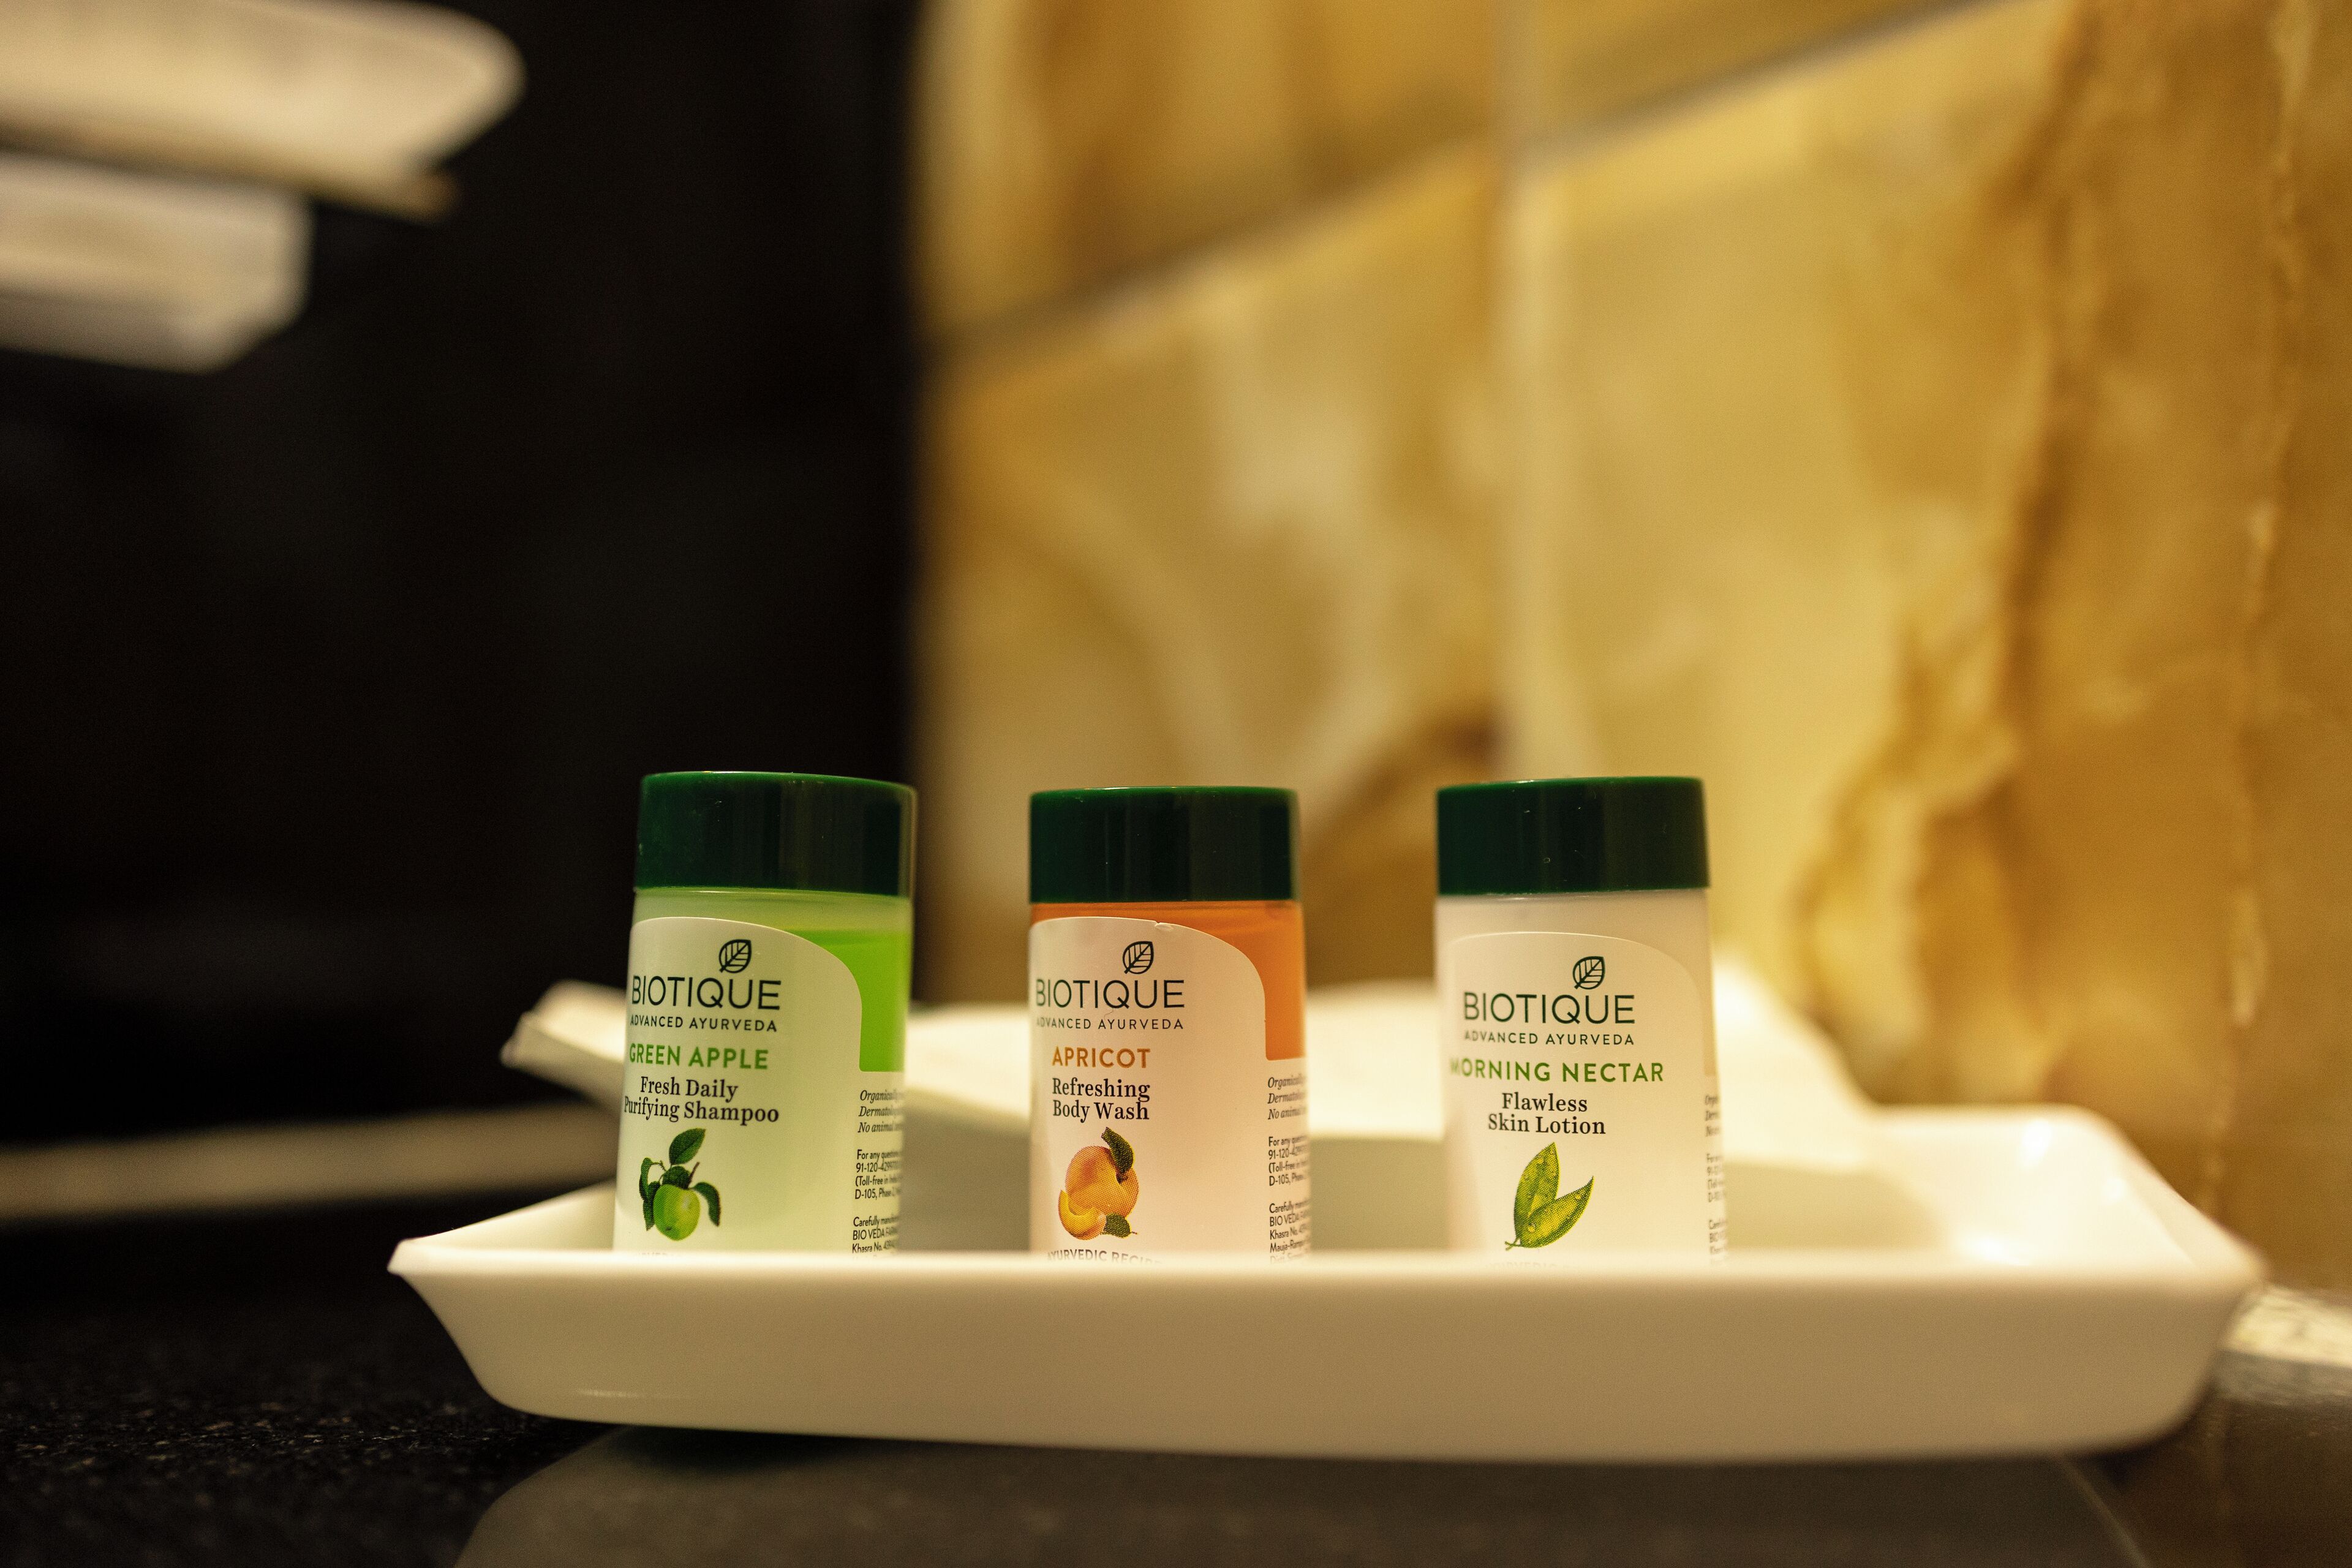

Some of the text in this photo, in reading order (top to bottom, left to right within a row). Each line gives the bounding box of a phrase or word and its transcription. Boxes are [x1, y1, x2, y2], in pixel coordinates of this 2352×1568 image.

[631, 975, 782, 1011] BIOTIQUE
[1036, 979, 1185, 1009] BIOTIQUE
[1463, 992, 1635, 1024] BIOTIQUE
[630, 1015, 777, 1032] ADVANCED AYURVEDA
[1036, 1017, 1183, 1030] ADVANCED AYURVEDA
[1464, 1031, 1634, 1045] ADVANCED AYURVEDA
[629, 1043, 769, 1069] GREEN APPLE
[1052, 1046, 1150, 1069] APRICOT
[1450, 1058, 1664, 1082] MORNING NECTAR
[640, 1076, 738, 1102] Fresh Daily
[1052, 1077, 1150, 1102] Refreshing
[1502, 1092, 1588, 1112] Flawless
[624, 1096, 779, 1126] Purifying Shampoo
[1053, 1099, 1150, 1123] Body Wash
[1268, 1109, 1279, 1120] No
[858, 1122, 870, 1133] No
[1488, 1114, 1606, 1134] Skin Lotion
[1268, 1136, 1280, 1147] For
[1281, 1139, 1291, 1149] any
[857, 1149, 869, 1159] For
[870, 1152, 880, 1163] any
[855, 1175, 883, 1186] (Toll-free
[1269, 1174, 1291, 1186] D-105,
[855, 1188, 877, 1200] D-105,
[1269, 1201, 1294, 1213] Carefully
[853, 1215, 880, 1229] Carefully
[1270, 1216, 1283, 1227] BIO
[853, 1229, 867, 1240] BIO
[868, 1228, 884, 1238] VEDA
[1270, 1230, 1289, 1240] Khasra
[852, 1243, 872, 1253] Khasra
